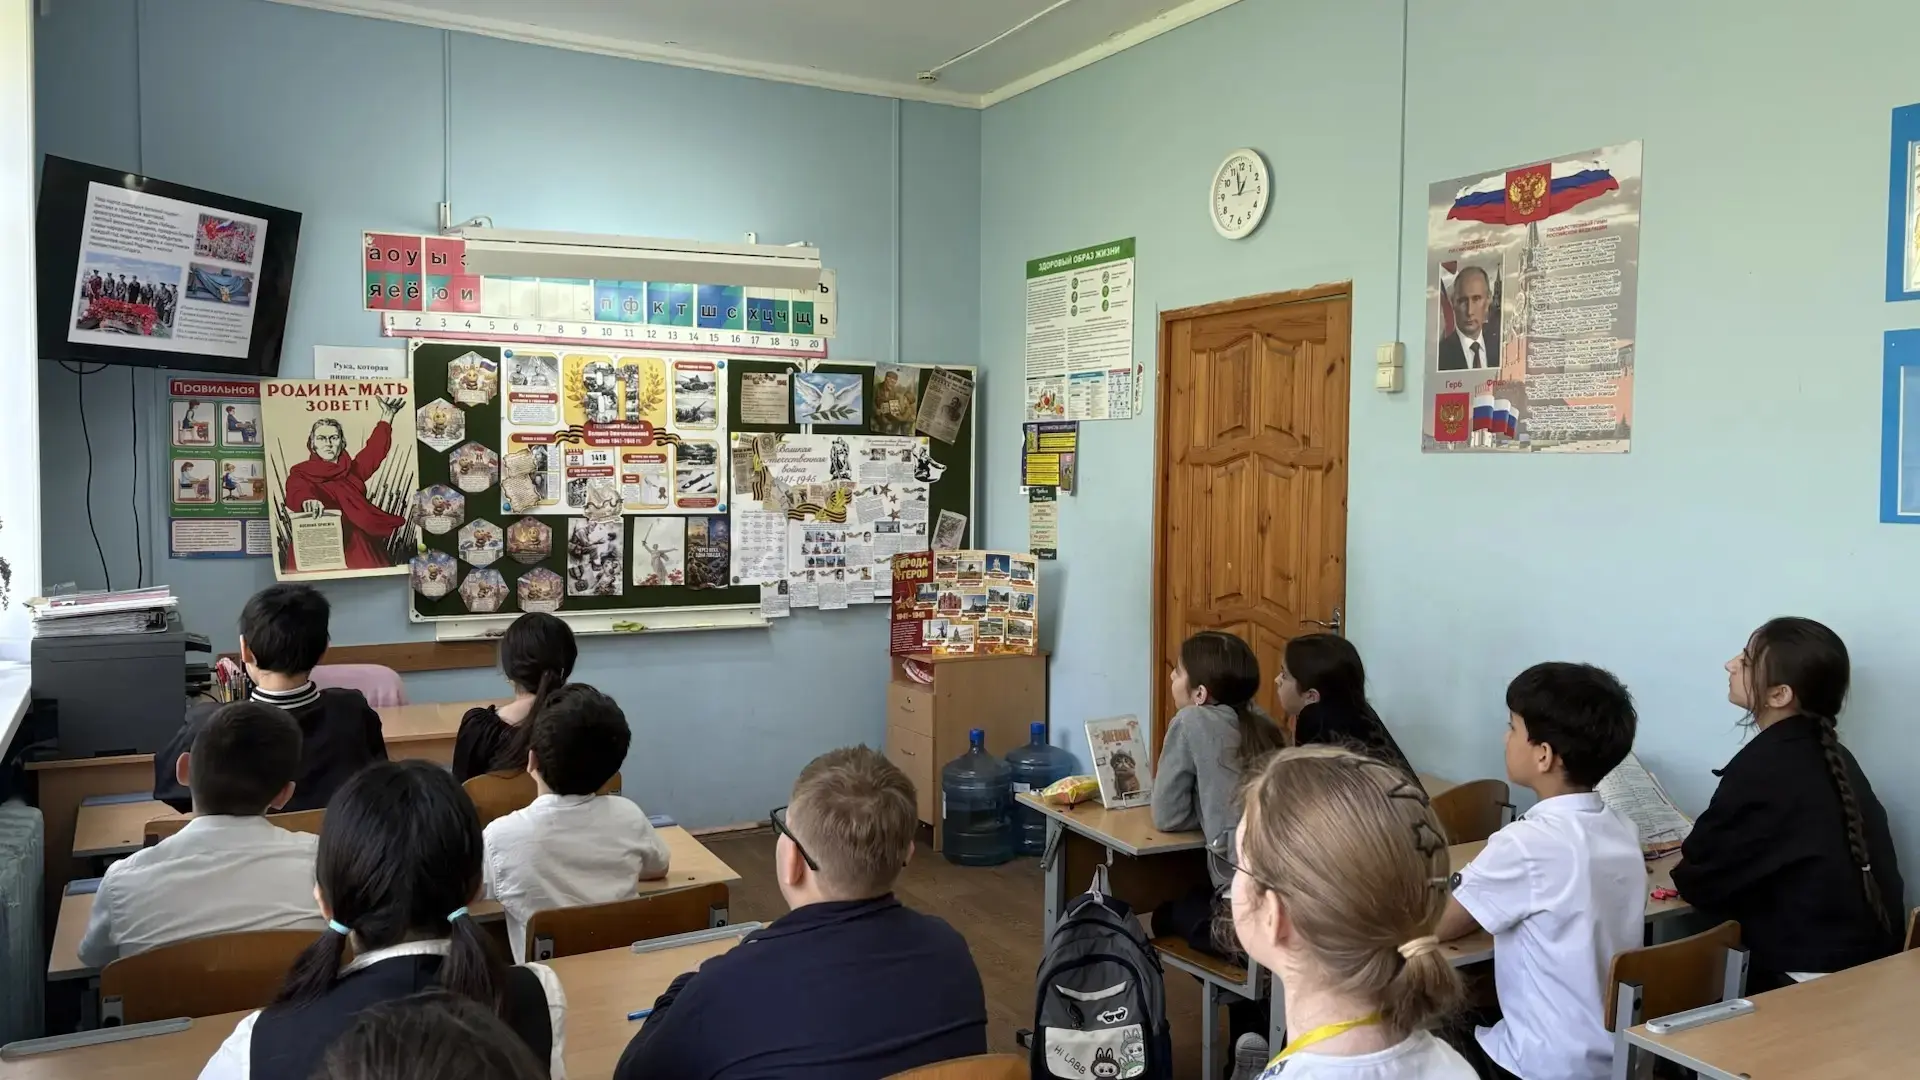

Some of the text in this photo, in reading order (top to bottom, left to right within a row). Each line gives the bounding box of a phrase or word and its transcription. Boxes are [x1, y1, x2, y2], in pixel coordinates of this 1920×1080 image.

[1255, 173, 1259, 181] 2
[1224, 180, 1230, 188] 10
[1257, 186, 1260, 194] 3
[1230, 215, 1234, 223] 7
[370, 248, 446, 265] а о у ы
[1038, 246, 1120, 272] ЗДОРОВЫЙ ОБРАЗ ЖИЗНИ
[370, 282, 473, 300] я е ё ю и
[623, 297, 638, 314] ф
[653, 302, 664, 313] к
[677, 304, 686, 316] т
[702, 306, 717, 317] ш
[727, 308, 736, 319] с
[749, 309, 757, 320] х
[764, 310, 773, 323] ц
[777, 311, 787, 322] ч
[796, 313, 811, 326] щ
[390, 317, 819, 348] 1 2 3 4 5 6 7 8 9 10 11 12 13 14 15 16 17 18 19 20
[334, 362, 355, 371] Рука,
[174, 382, 255, 394] Правильная
[268, 383, 408, 397] РОДИНА-МАТЬ
[1446, 380, 1462, 389] Герб
[306, 400, 368, 412] ЗОВЕТ!
[1064, 1053, 1086, 1074] LABB
